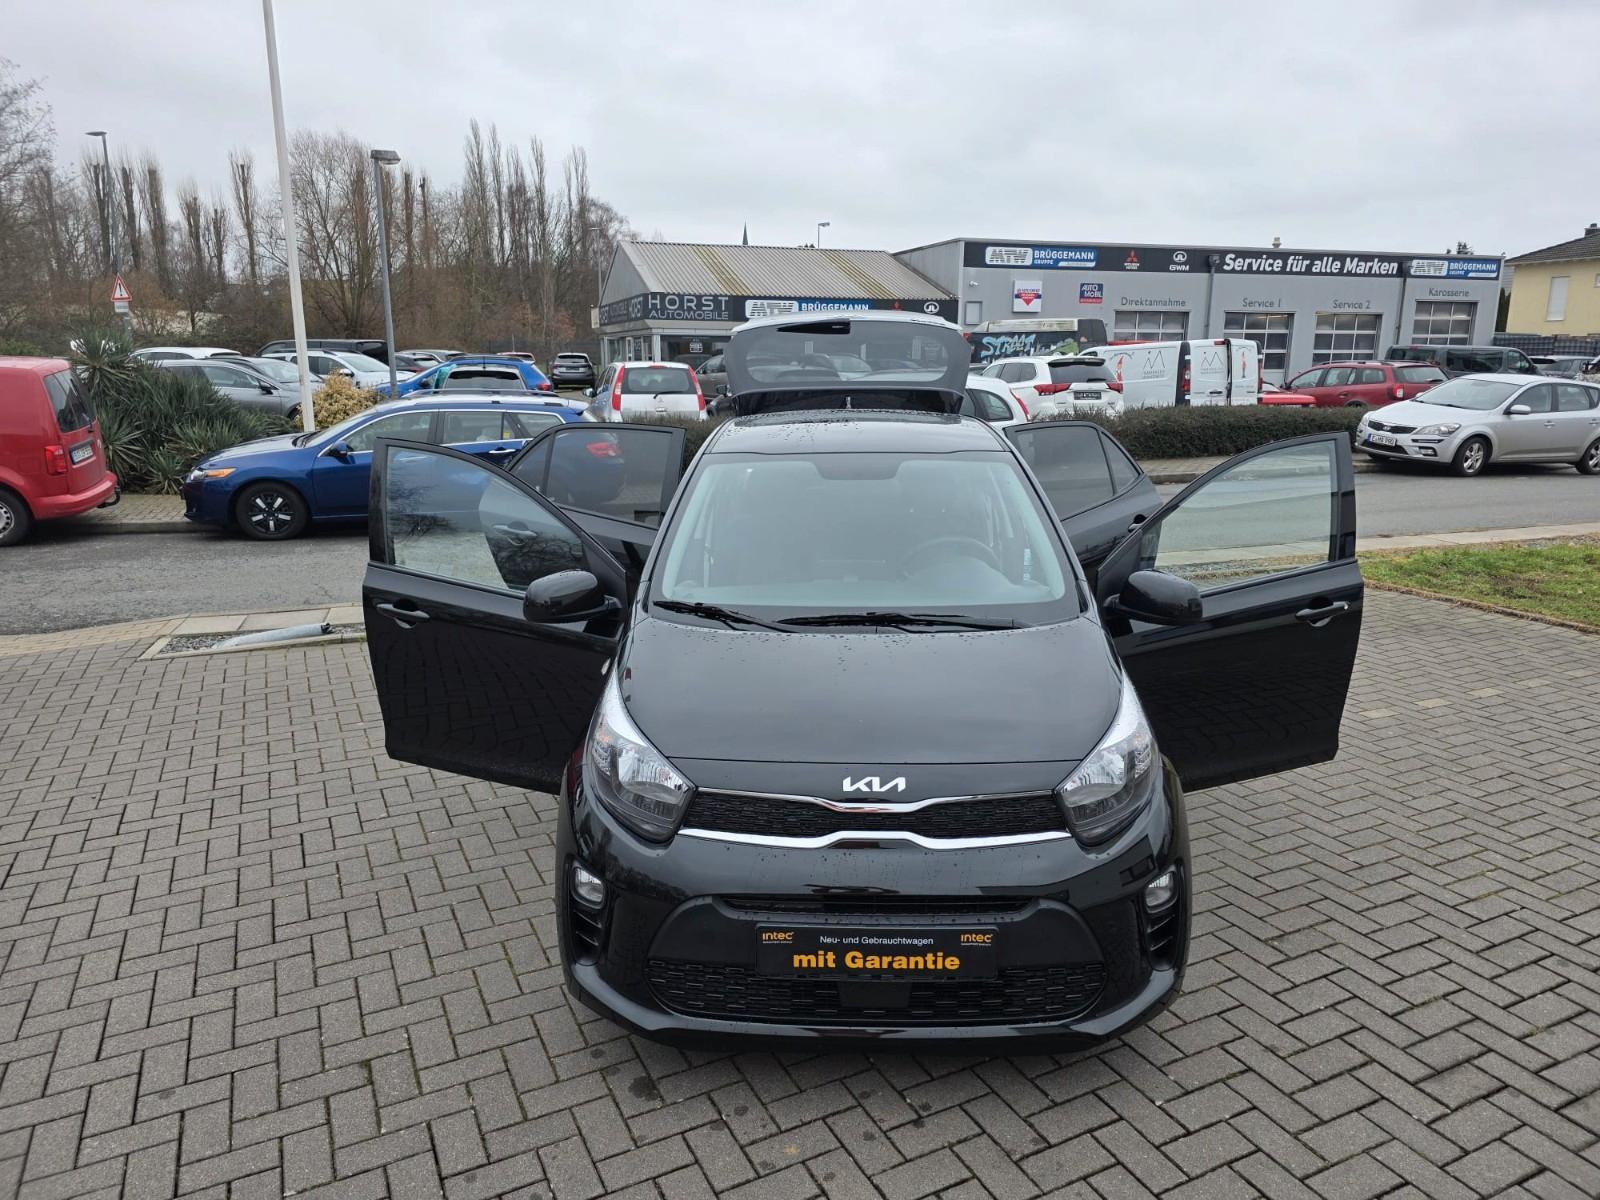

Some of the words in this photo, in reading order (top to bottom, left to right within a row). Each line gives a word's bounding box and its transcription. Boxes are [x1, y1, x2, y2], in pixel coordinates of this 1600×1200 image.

[1034, 248, 1095, 260] BRÜGGEMANN
[1223, 253, 1283, 271] Service
[1286, 256, 1310, 271] für
[1311, 257, 1341, 273] alle
[1343, 257, 1398, 275] Marken
[1449, 261, 1497, 271] BRÜGGEMANN
[1428, 287, 1470, 297] Karosserie
[648, 294, 729, 311] HORST
[801, 301, 869, 312] BRÜGGEMANN
[1120, 296, 1186, 307] Direktannahme
[1242, 297, 1275, 308] Service
[1332, 299, 1364, 309] Service
[1365, 300, 1371, 309] 2
[649, 310, 729, 320] AUTOMOBILE
[762, 931, 794, 940] intec
[960, 933, 993, 942] intec
[820, 936, 841, 944] Neu-
[843, 936, 860, 944] und
[861, 936, 934, 947] Gebrauchtwagen
[793, 950, 836, 968] mit
[845, 951, 960, 970] Garantie
